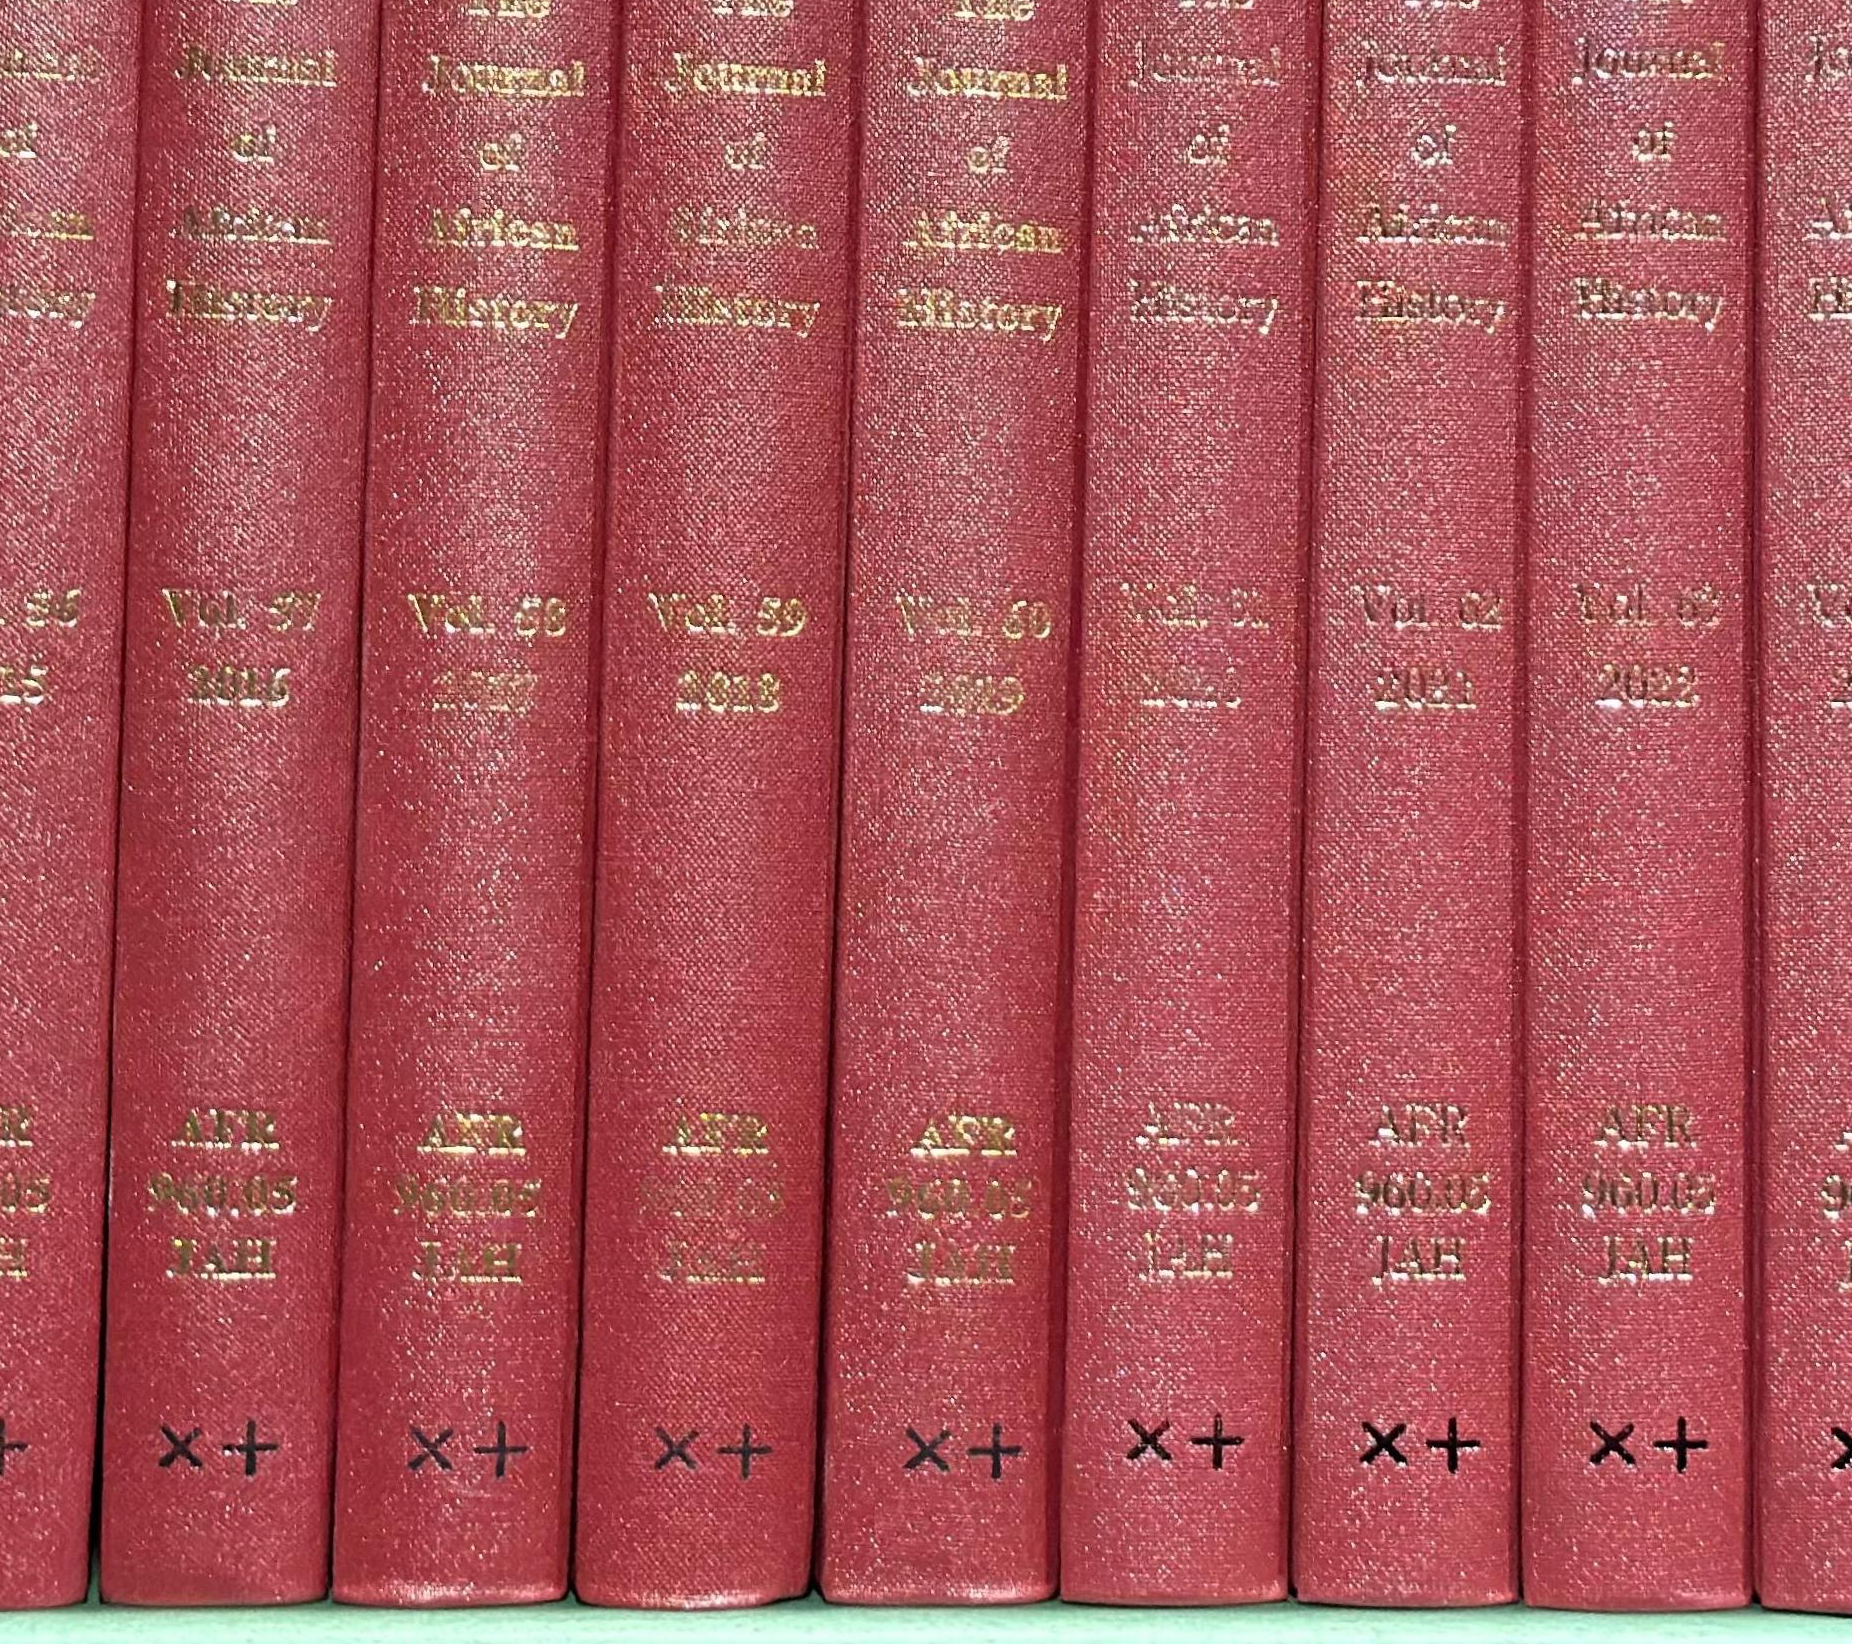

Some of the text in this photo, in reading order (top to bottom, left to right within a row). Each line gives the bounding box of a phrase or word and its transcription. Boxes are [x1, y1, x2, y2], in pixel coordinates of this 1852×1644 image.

[423, 56, 584, 97] Journal
[665, 54, 826, 96] Journal
[907, 57, 1068, 99] Journal
[1574, 38, 1724, 84] Journal
[479, 133, 520, 172] of
[724, 133, 765, 170] of
[967, 137, 1008, 174] of
[1411, 125, 1455, 164] of
[1633, 123, 1674, 161] of
[427, 207, 579, 249] African
[904, 212, 1064, 254] African
[1356, 205, 1507, 246] African
[1574, 199, 1726, 241] African
[410, 287, 578, 338] History
[654, 285, 820, 338] History
[898, 288, 1062, 341] History
[1356, 280, 1504, 333] History
[1574, 277, 1726, 330] History
[515, 596, 566, 637] 58
[757, 598, 806, 637] 59
[1004, 601, 1051, 638] 60
[1458, 591, 1501, 630] 62
[677, 670, 779, 712] 2018
[1375, 667, 1476, 710] 2021
[1595, 665, 1698, 708] 2022
[418, 1112, 525, 1155] AFR
[662, 1112, 769, 1155] AFR
[910, 1115, 1016, 1156] AFR
[1369, 1104, 1470, 1147] AFR
[1594, 1104, 1696, 1149] AFR
[394, 1177, 541, 1218] 960.05
[888, 1179, 1031, 1219] 960.05
[1356, 1171, 1491, 1215] 960.05
[1581, 1171, 1716, 1217] 960.05
[1372, 1235, 1465, 1283] JAH
[1599, 1237, 1692, 1282] JAH
